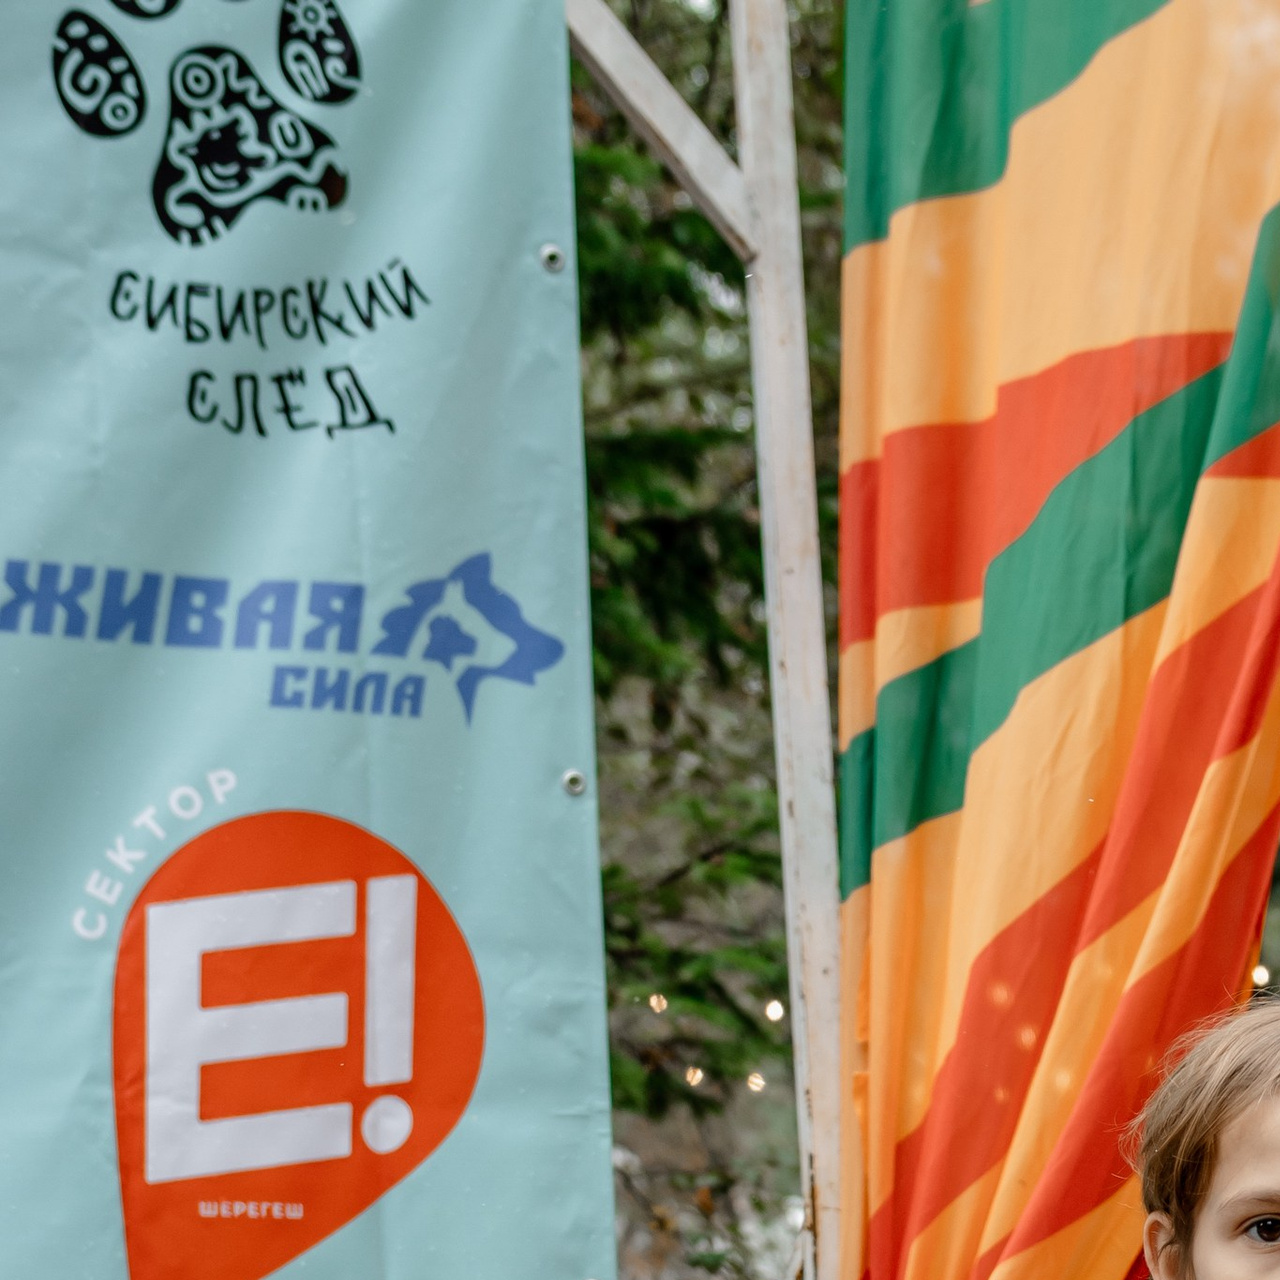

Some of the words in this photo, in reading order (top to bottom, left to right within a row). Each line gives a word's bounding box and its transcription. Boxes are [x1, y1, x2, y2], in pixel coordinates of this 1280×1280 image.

[0, 558, 366, 654] ЖИВАЯ
[269, 665, 426, 717] СИЛА
[72, 768, 237, 940] СЕКТОР
[199, 1200, 304, 1220] ШЕРЕГЕШ
